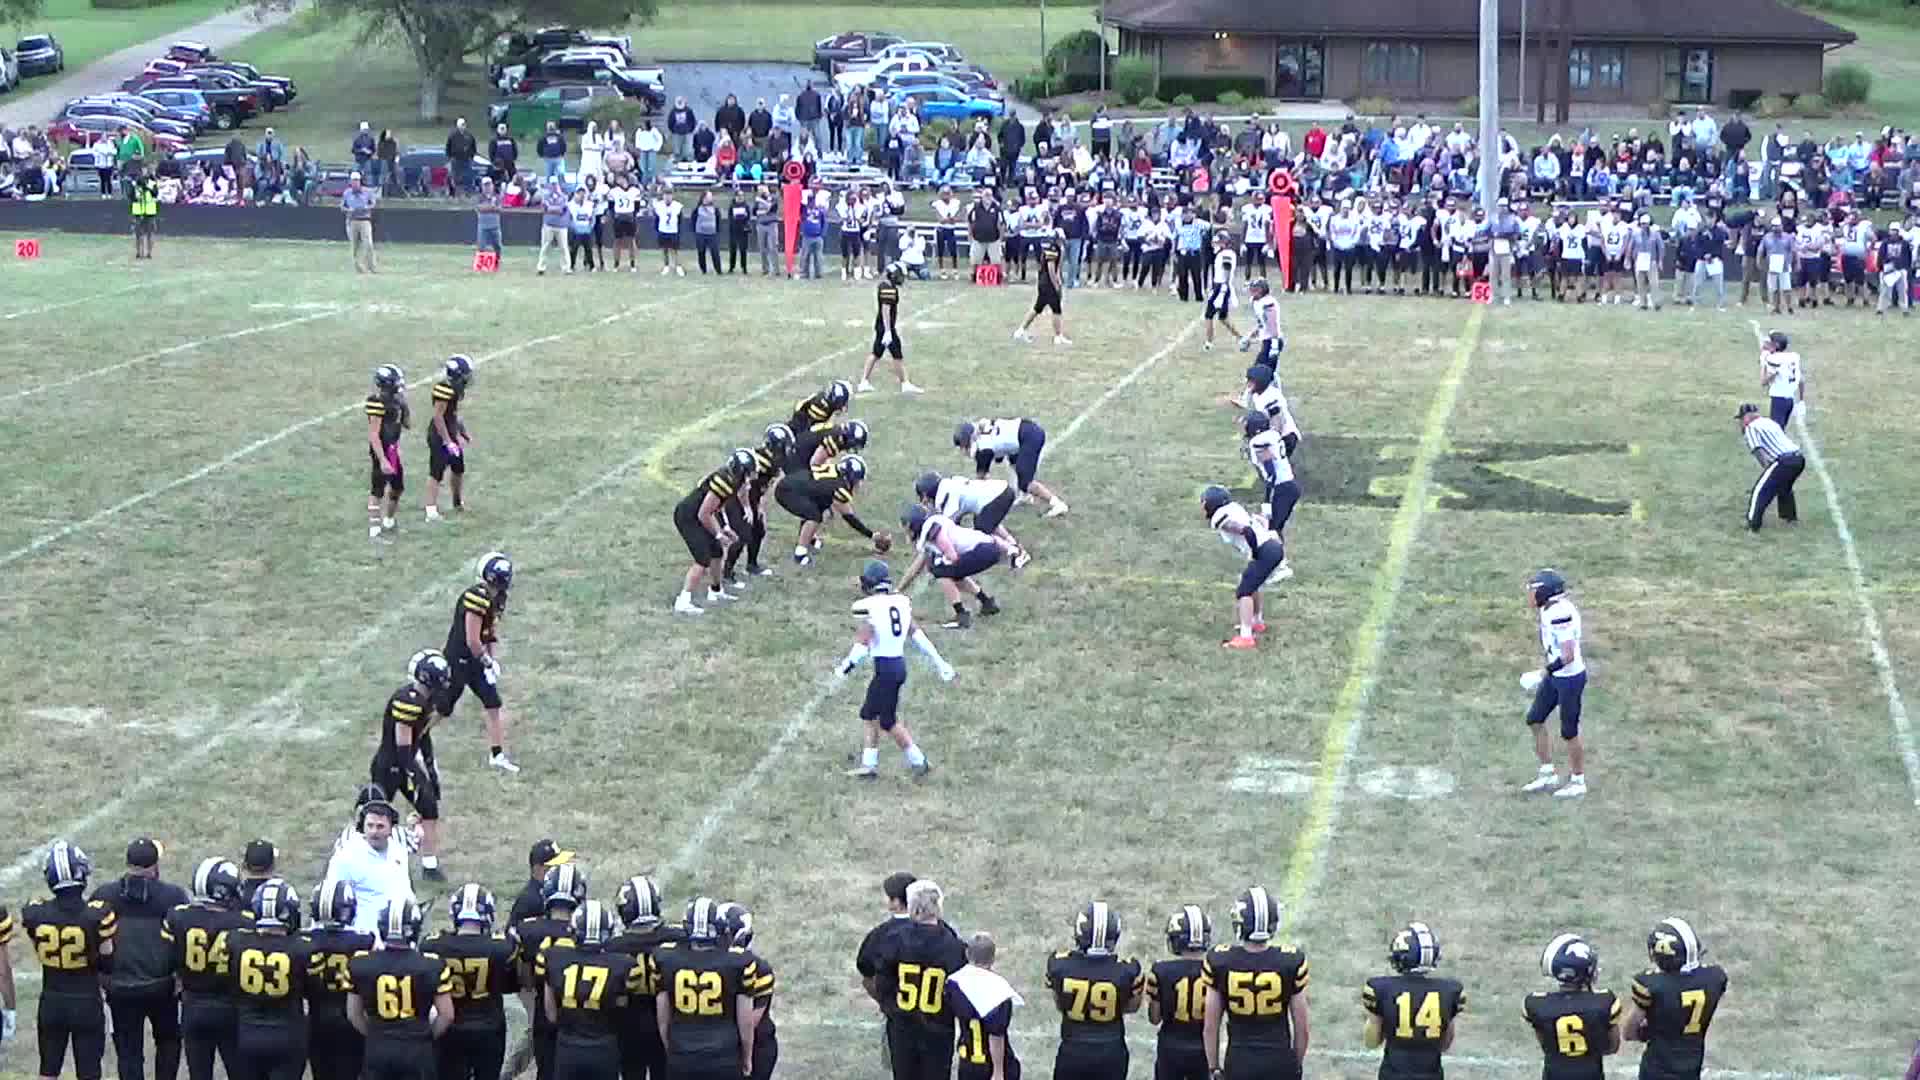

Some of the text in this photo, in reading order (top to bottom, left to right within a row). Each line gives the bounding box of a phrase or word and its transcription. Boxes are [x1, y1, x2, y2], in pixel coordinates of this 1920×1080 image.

[17, 241, 34, 257] 20
[889, 606, 902, 637] 8
[35, 923, 88, 969] 22
[185, 927, 230, 973] 64
[239, 948, 291, 996] 63
[562, 963, 609, 1009] 17
[674, 968, 723, 1015] 62
[897, 962, 946, 1013] 50
[1228, 970, 1282, 1015] 52
[376, 974, 415, 1019] 61
[1063, 977, 1118, 1022] 79
[1395, 991, 1442, 1039] 14
[1681, 989, 1706, 1035] 7
[1555, 1014, 1588, 1057] 6
